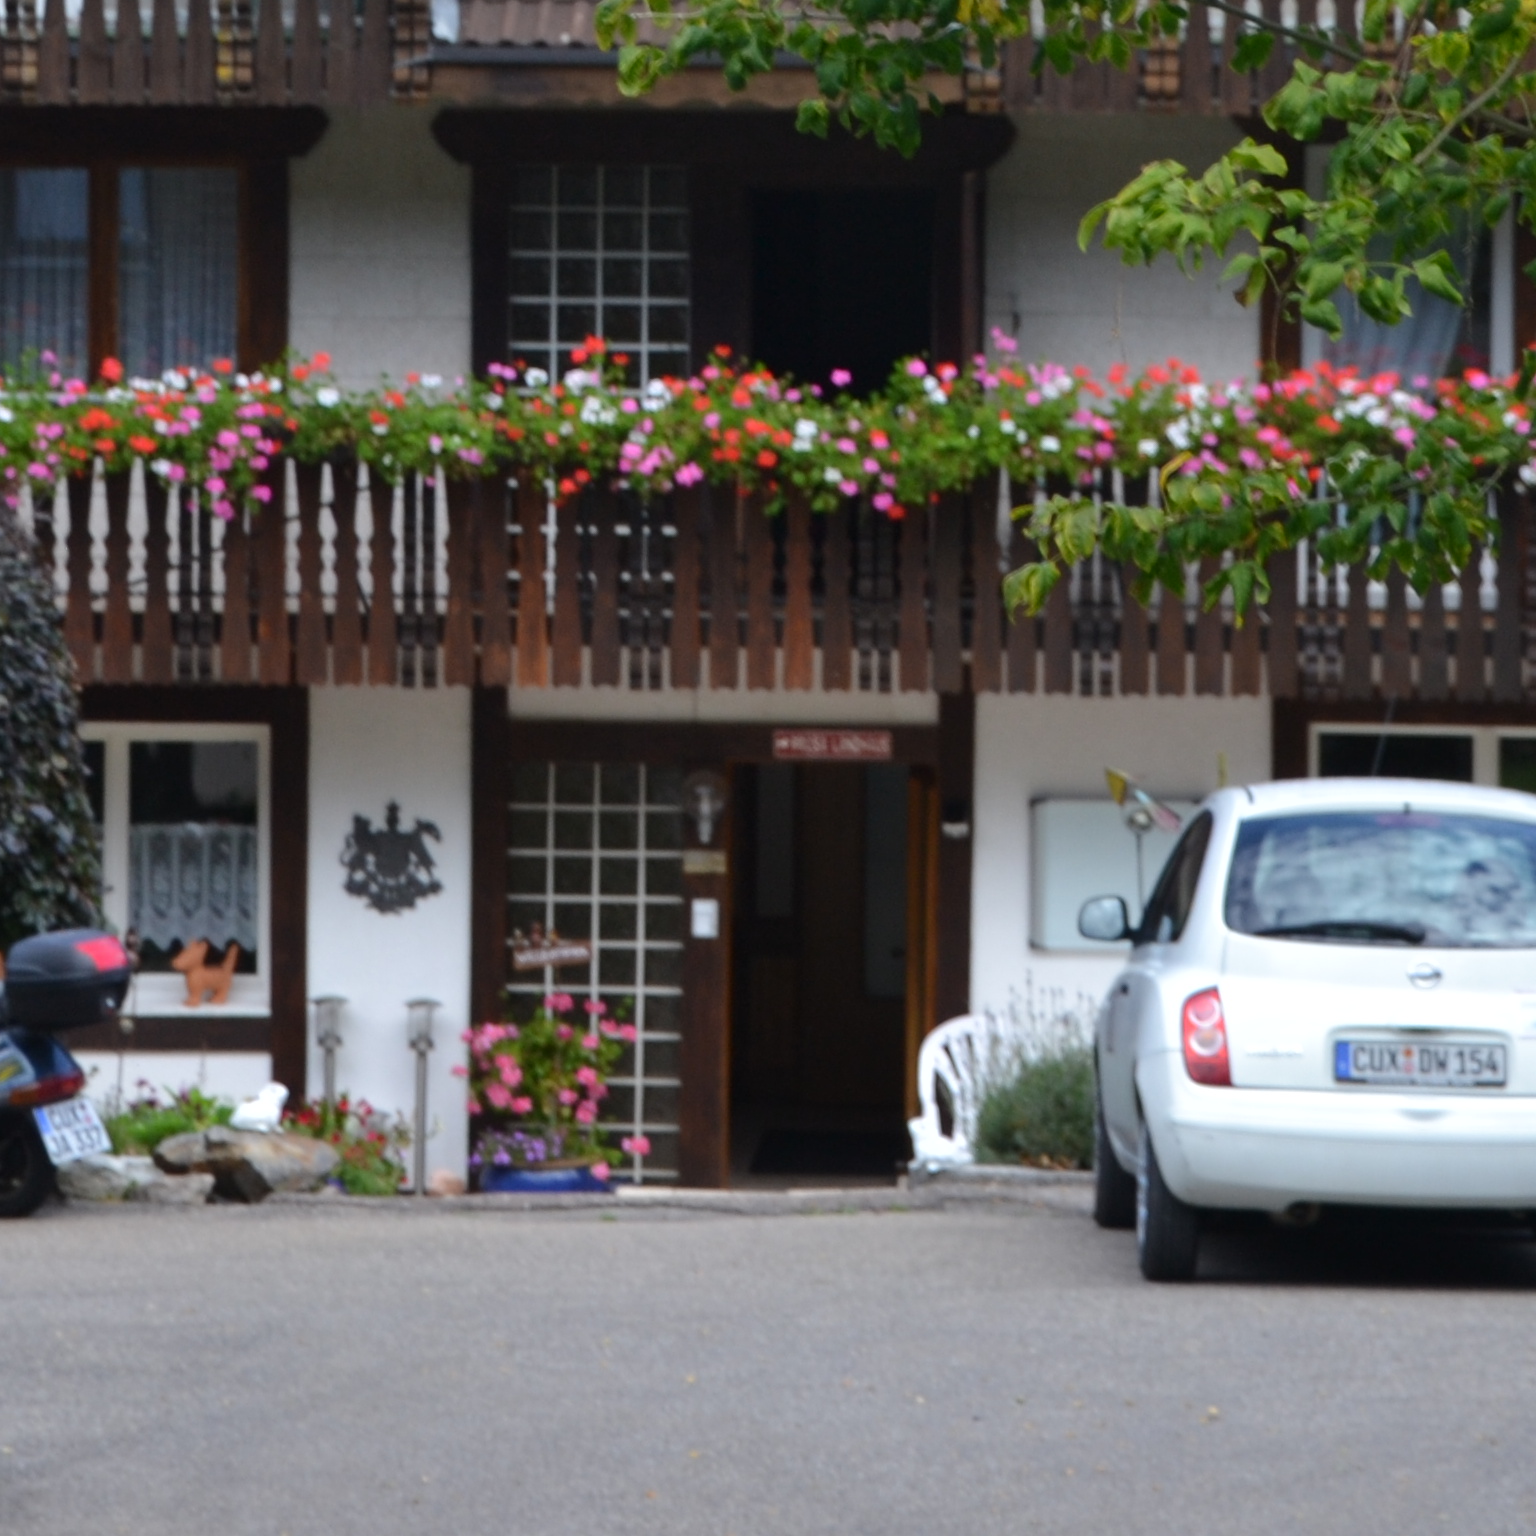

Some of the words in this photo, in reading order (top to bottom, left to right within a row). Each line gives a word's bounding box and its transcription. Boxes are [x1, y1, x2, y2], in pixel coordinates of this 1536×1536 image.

[1353, 1046, 1399, 1073] CUX
[1455, 1049, 1499, 1076] 154
[48, 1105, 82, 1131] CUX
